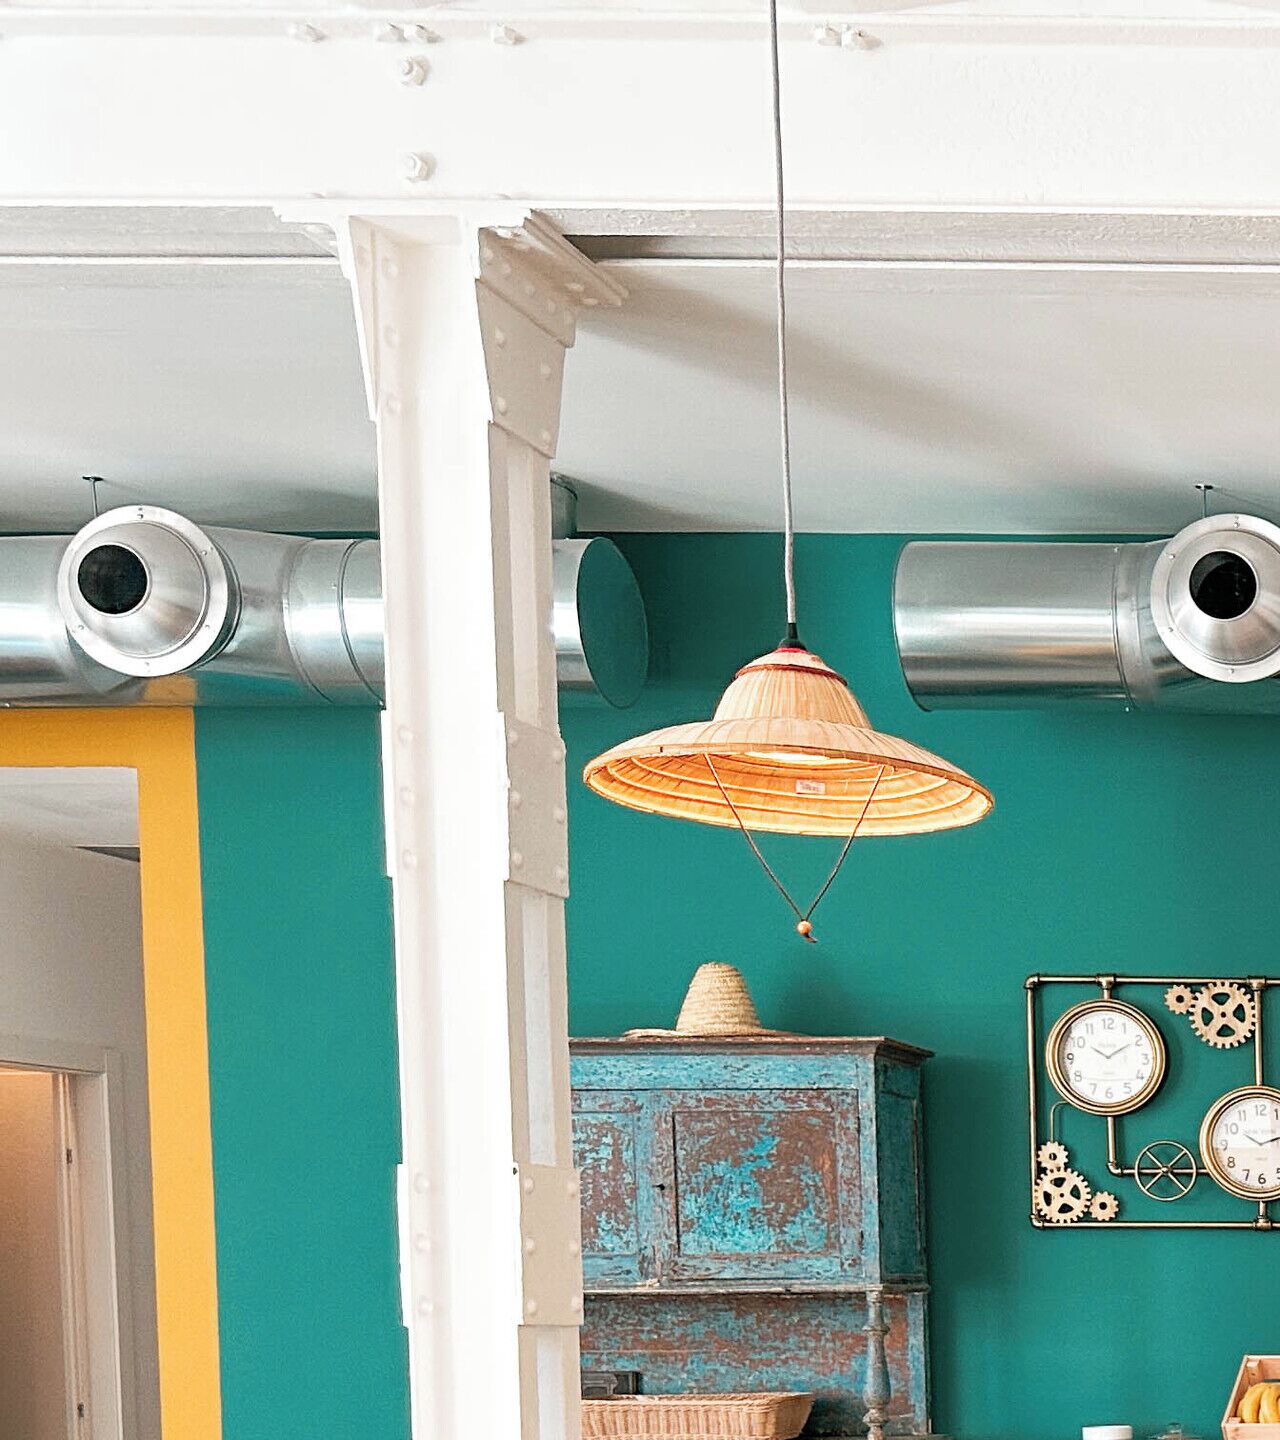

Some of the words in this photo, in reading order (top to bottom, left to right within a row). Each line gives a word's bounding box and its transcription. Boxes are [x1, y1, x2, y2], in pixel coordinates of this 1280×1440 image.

[1085, 1023, 1094, 1035] 11
[1101, 1017, 1114, 1030] 12
[1070, 1036, 1086, 1048] 10
[1135, 1034, 1142, 1046] 2
[1067, 1053, 1074, 1065] 9
[1142, 1053, 1149, 1065] 3
[1074, 1070, 1082, 1082] 8
[1136, 1070, 1144, 1080] 4
[1089, 1083, 1097, 1095] 7
[1105, 1087, 1114, 1099] 6
[1123, 1082, 1132, 1094] 5
[1238, 1110, 1247, 1121] 11
[1254, 1104, 1267, 1116] 12
[1224, 1123, 1239, 1135] 10
[1220, 1139, 1228, 1151] 9
[1227, 1156, 1235, 1168] 8
[1242, 1169, 1250, 1181] 7
[1258, 1173, 1266, 1184] 6
